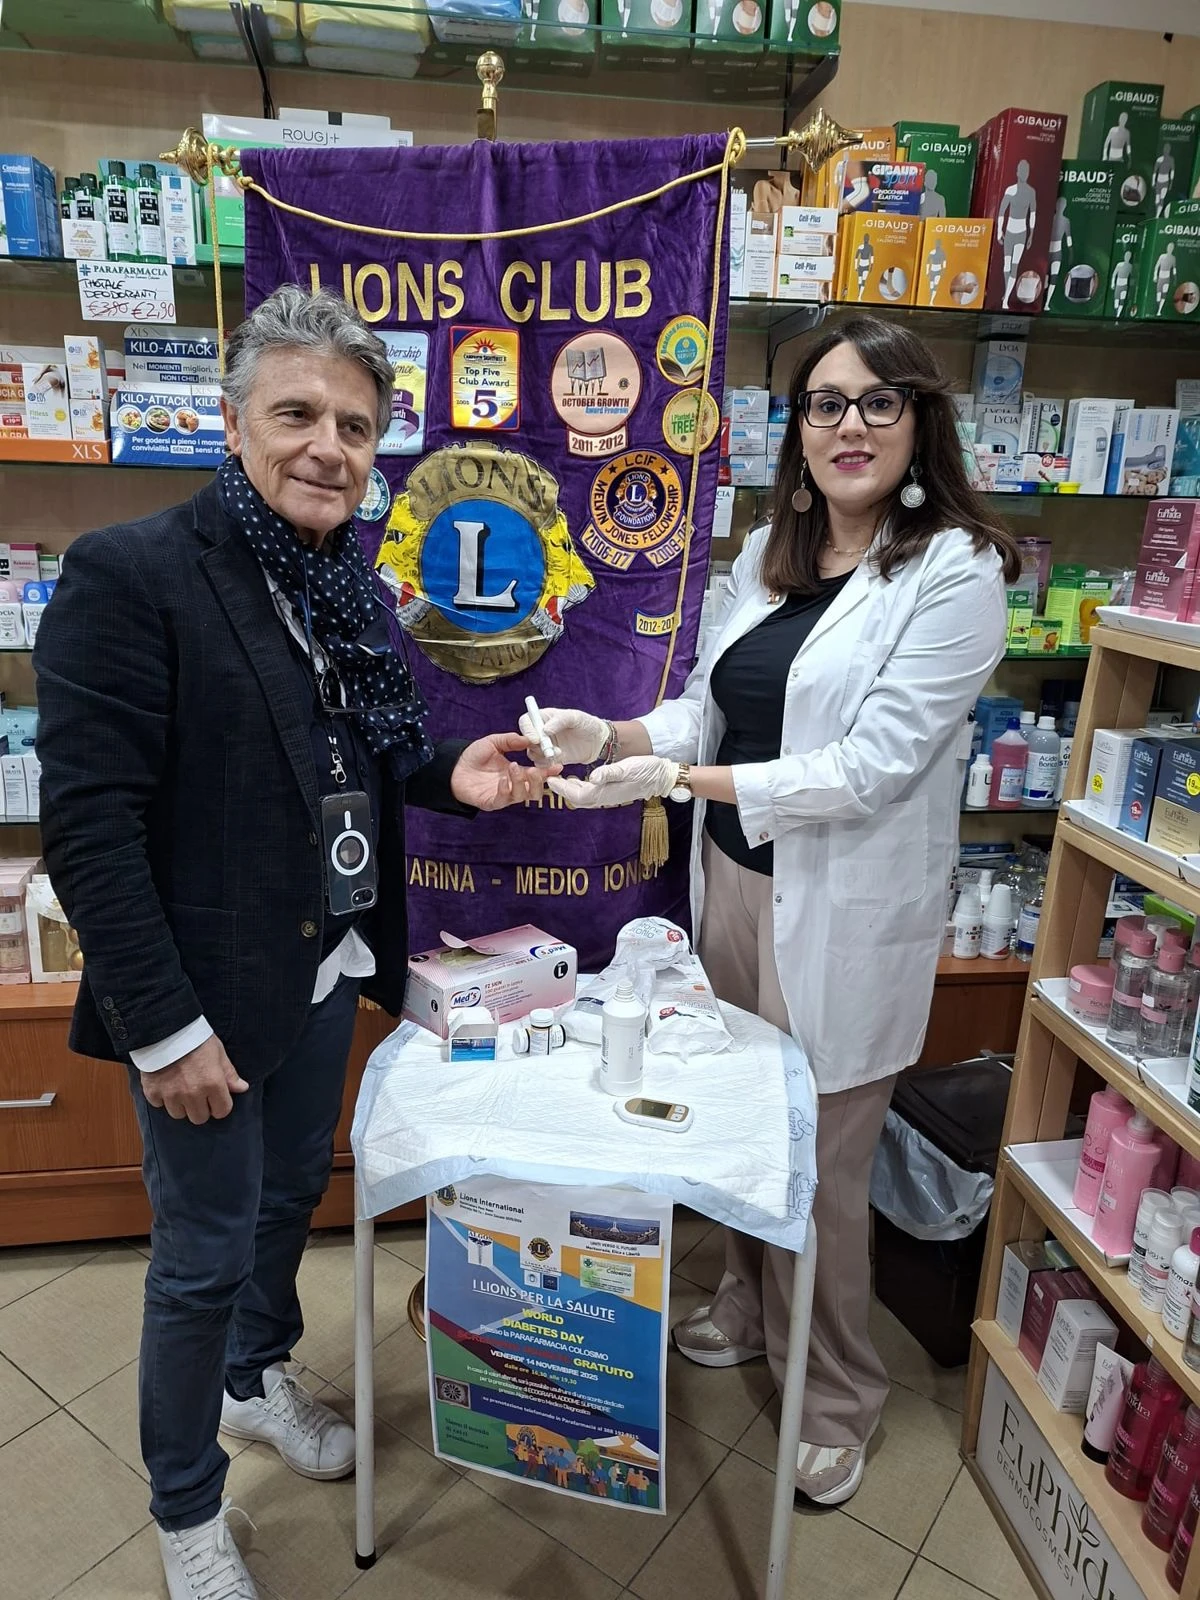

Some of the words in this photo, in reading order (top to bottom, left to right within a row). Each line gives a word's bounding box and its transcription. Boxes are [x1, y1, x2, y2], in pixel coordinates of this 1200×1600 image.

[1115, 91, 1154, 104] GIBAUD
[1017, 115, 1057, 128] GIBAUD
[843, 141, 885, 150] BAUD
[921, 142, 967, 153] GIBAUD
[872, 164, 918, 176] GIBAUD
[866, 219, 909, 230] GIBAUD
[935, 225, 981, 234] GIBAUD
[94, 265, 168, 276] PARAFARMACIA
[500, 259, 653, 323] CLUB
[131, 302, 175, 320] €2,90
[130, 341, 213, 356] KILO-ATTACK
[1, 352, 14, 362] LS
[148, 363, 181, 371] MOMENTI
[464, 366, 480, 376] Top
[482, 367, 500, 376] Five
[459, 377, 479, 386] Club
[481, 379, 510, 387] Award
[121, 394, 188, 406] KILO-ATTACK
[472, 390, 498, 418] 5
[562, 398, 596, 407] OCTOBER
[597, 398, 630, 407] GROWTH
[994, 415, 1019, 425] LYCIA
[671, 421, 695, 434] TREE
[145, 437, 170, 446] godersi
[72, 444, 102, 459] XLS
[624, 454, 657, 467] LCIF
[627, 474, 648, 482] LIONS
[630, 484, 642, 502] L
[594, 480, 609, 525] MELVIN
[605, 525, 639, 545] JONES
[642, 484, 679, 543] FELLOWSHIP
[616, 511, 656, 525] FOUNDATION
[453, 521, 518, 608] L
[638, 616, 675, 633] 2012-201
[406, 856, 475, 893] ARINA
[516, 866, 589, 896] MEDIO
[453, 992, 477, 1006] Med's
[460, 1192, 478, 1204] Lions
[479, 1198, 524, 1214] International
[480, 1281, 517, 1298] LIONS
[520, 1290, 544, 1305] PER
[548, 1295, 563, 1309] LA
[566, 1300, 615, 1321] SALUTE
[522, 1308, 564, 1325] WORLD
[503, 1318, 558, 1339] DIABETES
[560, 1331, 585, 1344] DAY
[510, 1332, 568, 1352] PARAFARMACIA
[568, 1345, 609, 1361] COLOSIMO
[536, 1360, 579, 1377] NOVEMBRE
[573, 1358, 634, 1380] GRATUITO
[999, 1400, 1115, 1600] EuPhid
[997, 1450, 1074, 1587] DERMOCOSMESI
